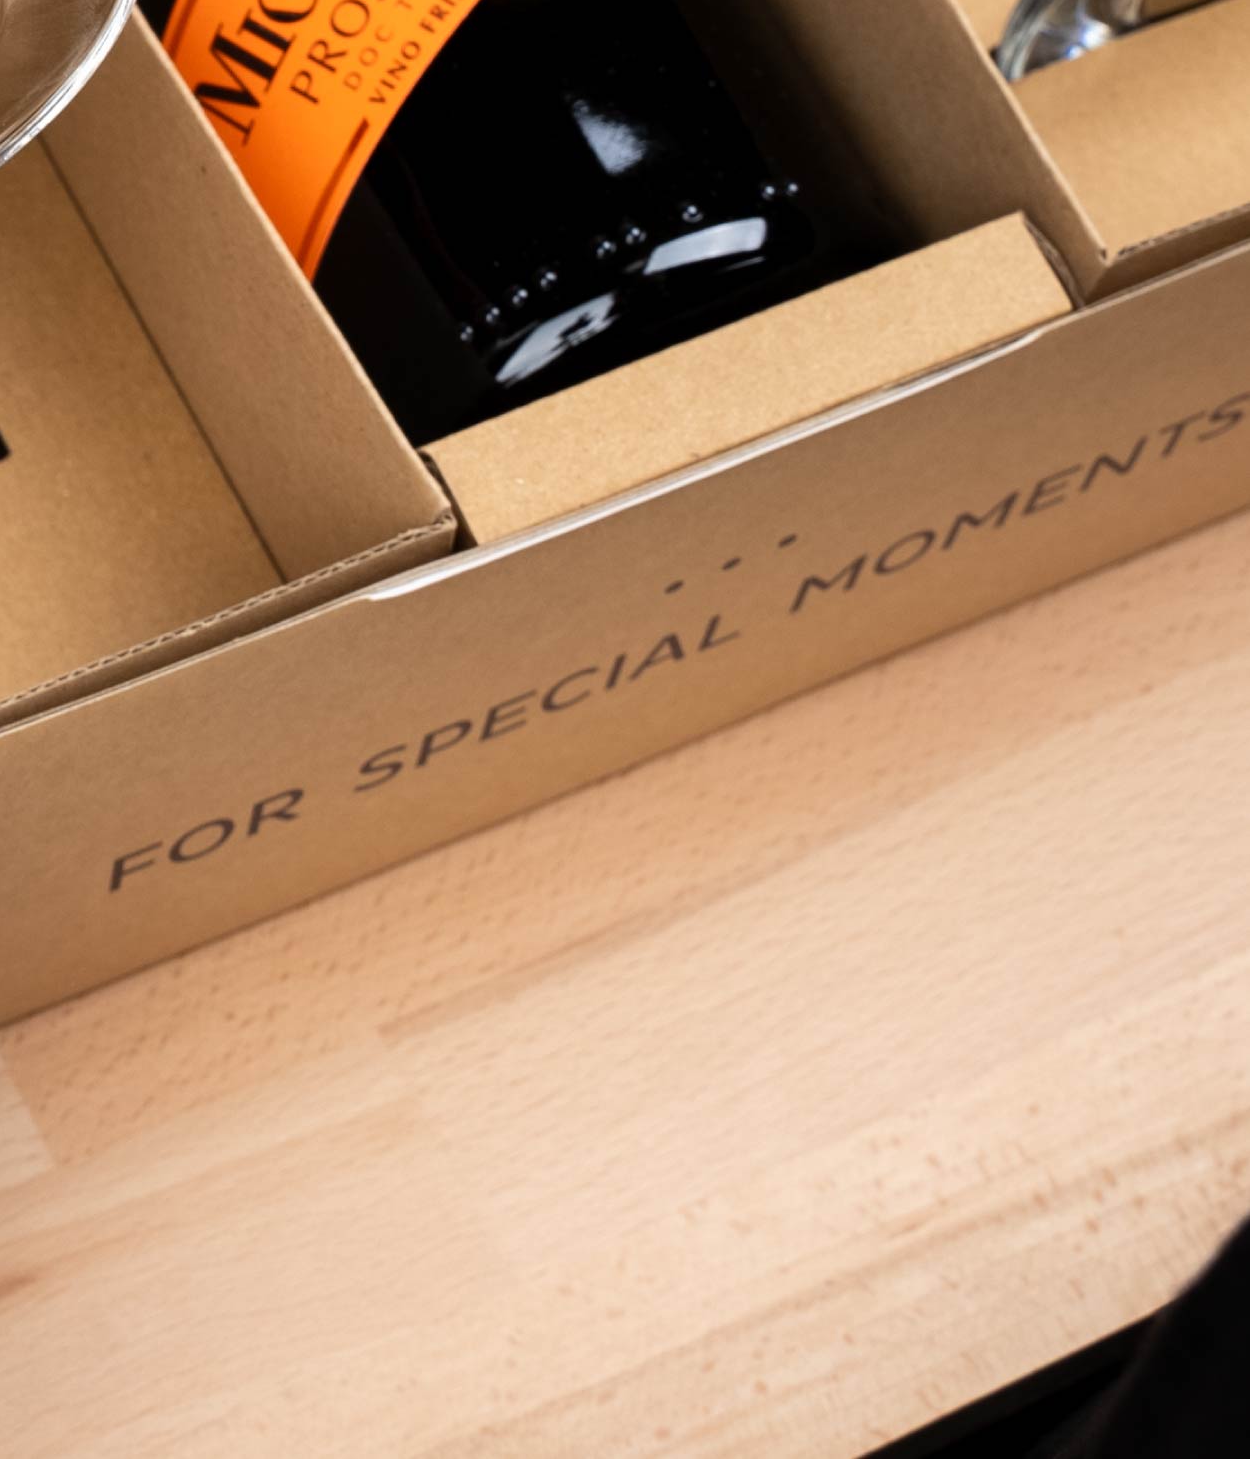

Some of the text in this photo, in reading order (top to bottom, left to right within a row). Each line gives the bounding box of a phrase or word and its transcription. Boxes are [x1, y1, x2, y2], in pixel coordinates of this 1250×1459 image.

[342, 23, 394, 92] DOC
[367, 40, 422, 106] VINO
[107, 390, 1250, 893] FOR SPECIAL MOMENTS
